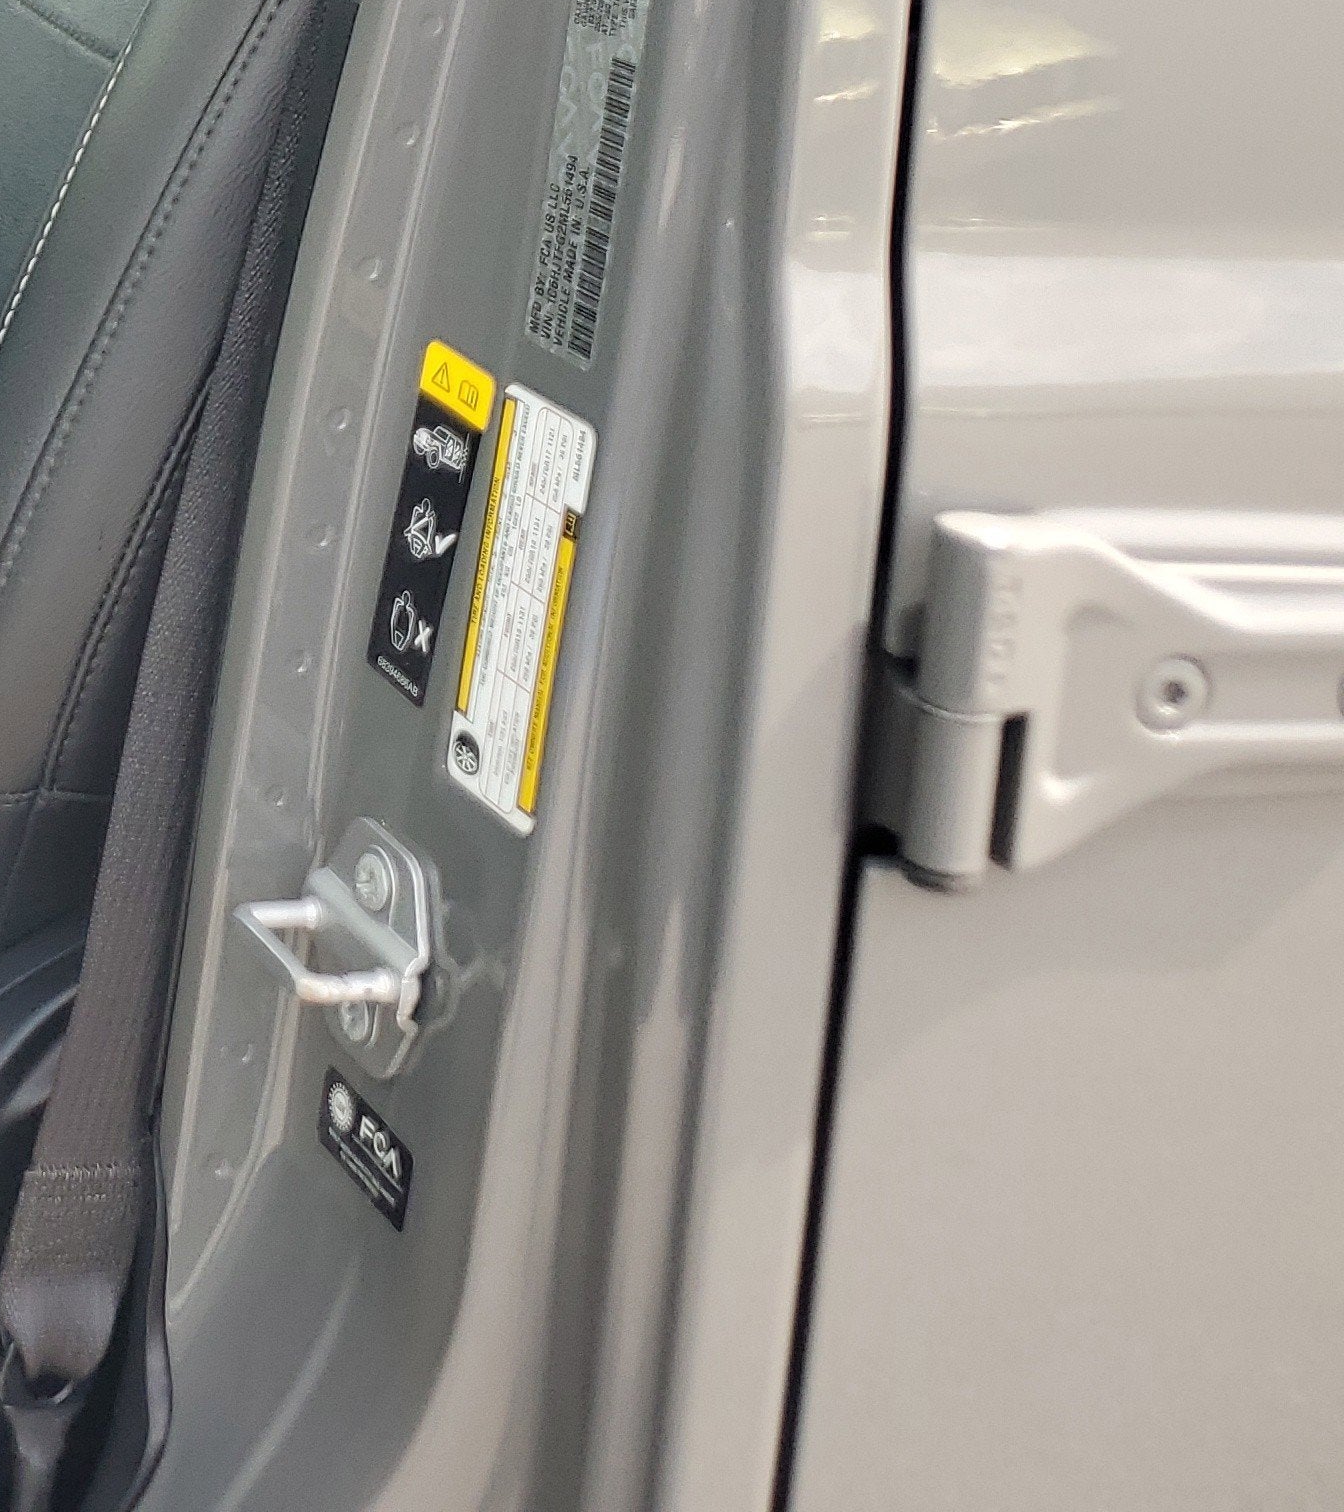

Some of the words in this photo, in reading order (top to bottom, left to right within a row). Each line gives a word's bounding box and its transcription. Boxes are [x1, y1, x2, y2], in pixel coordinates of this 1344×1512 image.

[548, 182, 560, 210] LLC
[544, 212, 556, 233] US
[539, 238, 552, 267] FCA
[554, 286, 571, 346] VEHICLE
[563, 240, 577, 283] MADE
[529, 300, 542, 334] MFD
[477, 540, 489, 581] LOADING
[485, 476, 499, 539] INFORMATION
[359, 1114, 404, 1181] FCA
